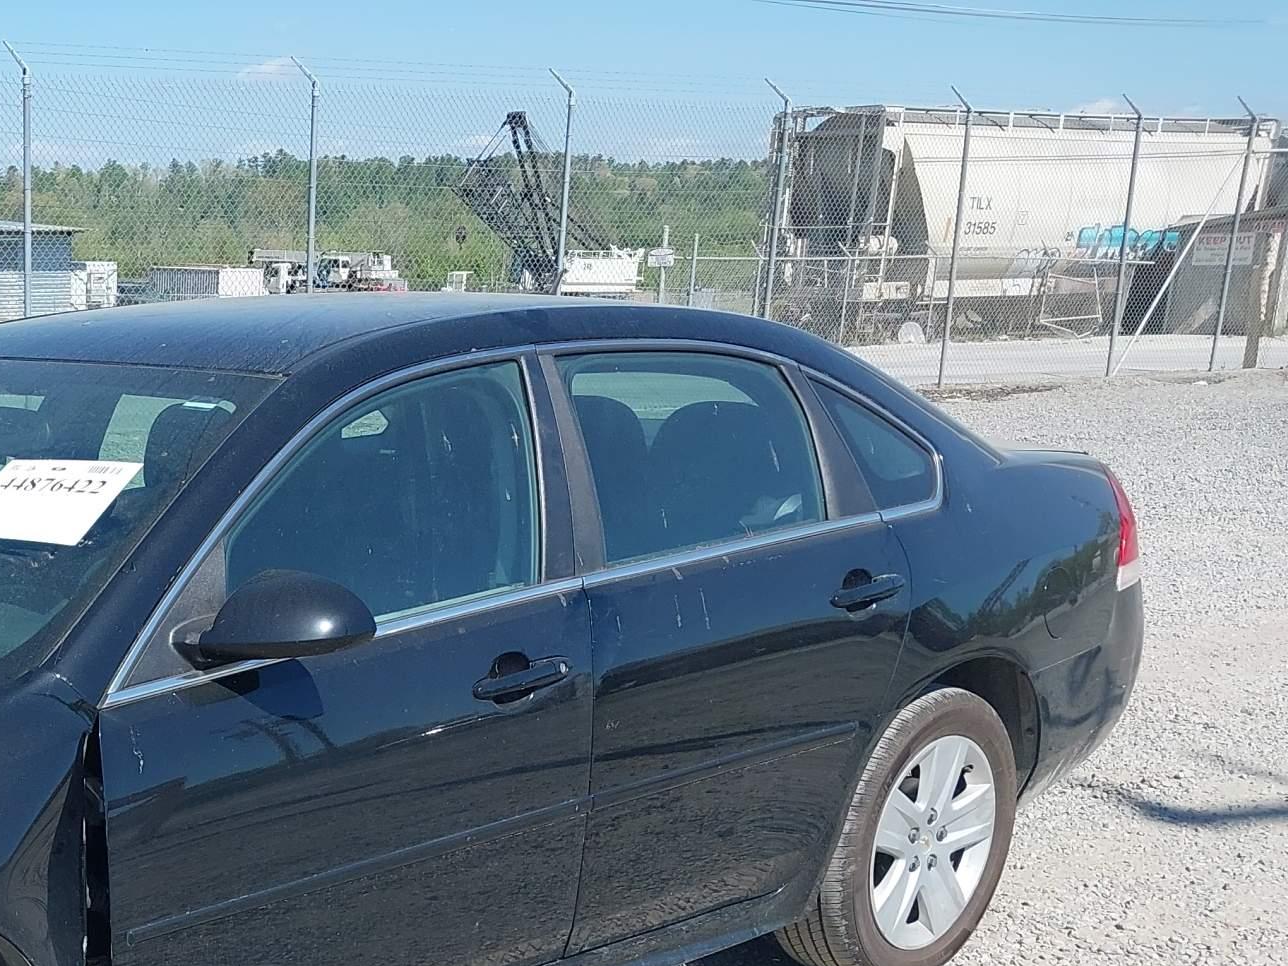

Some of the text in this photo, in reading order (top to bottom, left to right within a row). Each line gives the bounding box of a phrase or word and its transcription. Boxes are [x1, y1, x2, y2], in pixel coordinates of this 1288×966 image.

[969, 195, 993, 211] TILX
[963, 221, 997, 236] 31585
[1197, 236, 1226, 246] KEEP
[0, 476, 108, 495] 44876422
